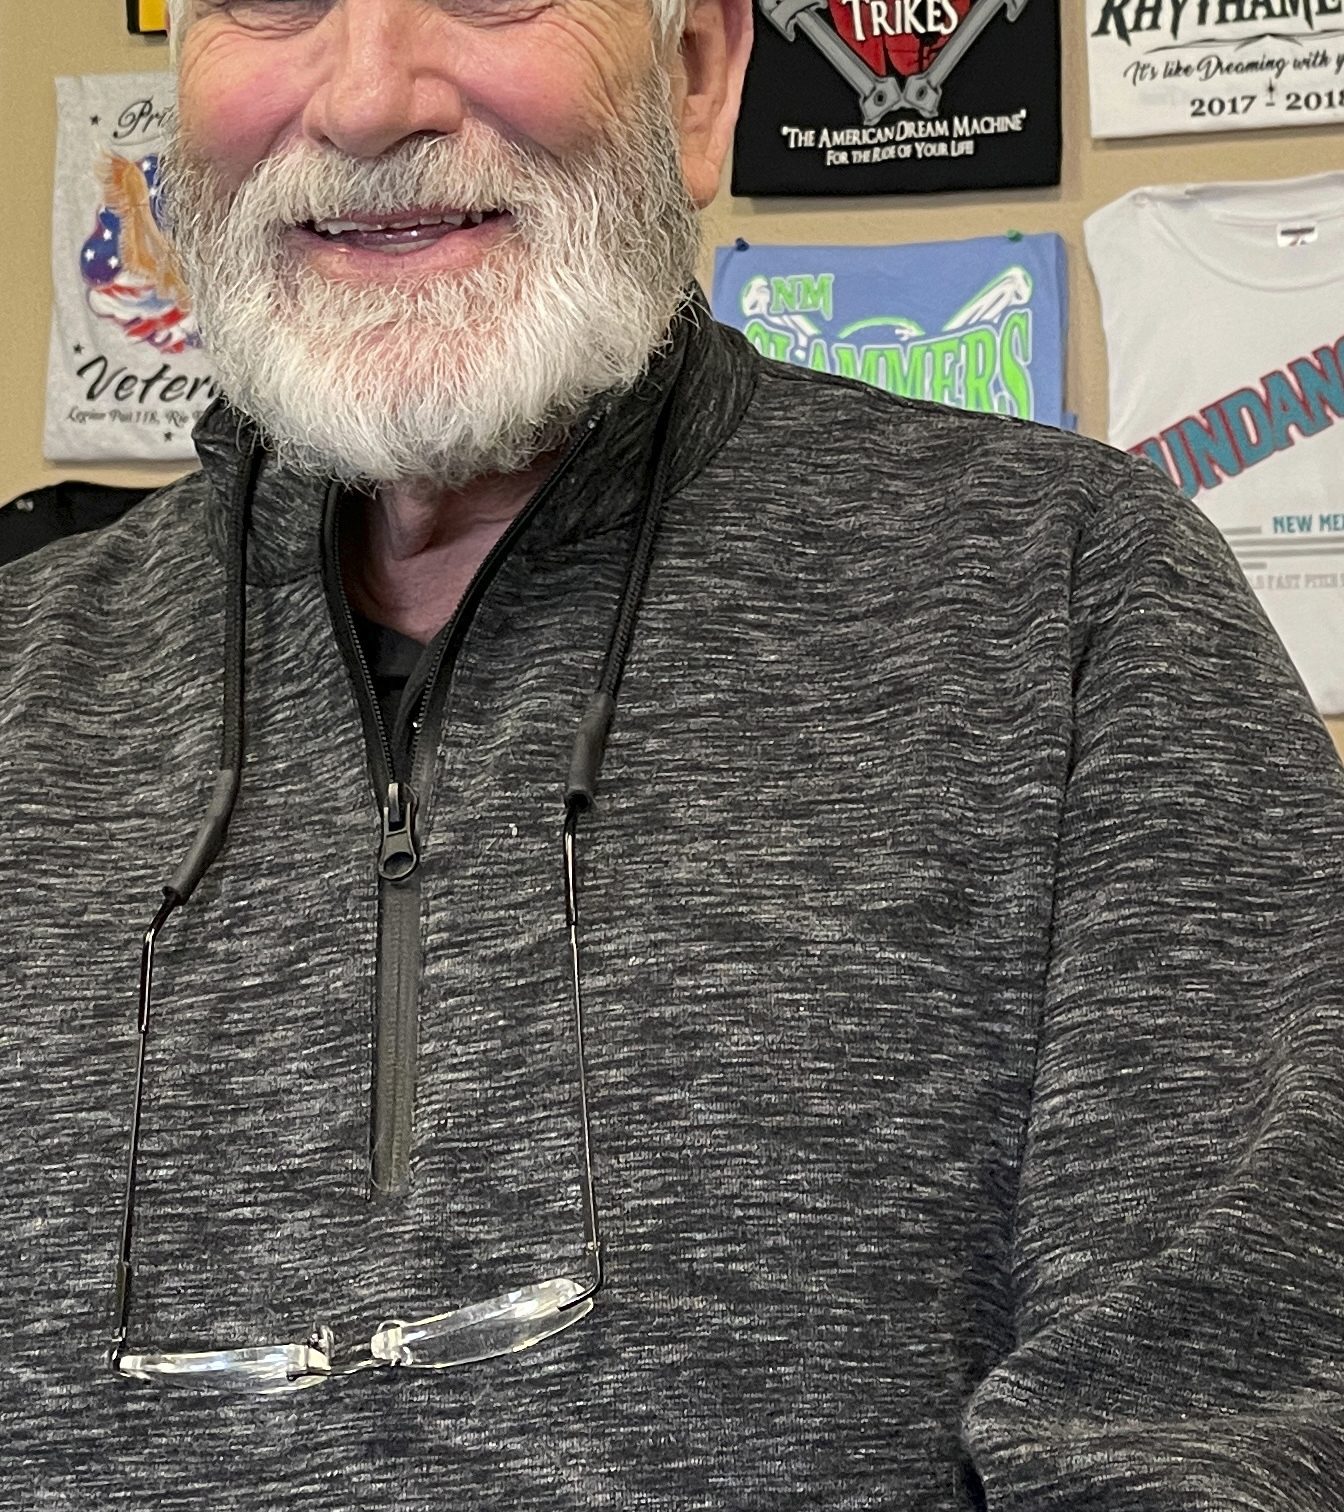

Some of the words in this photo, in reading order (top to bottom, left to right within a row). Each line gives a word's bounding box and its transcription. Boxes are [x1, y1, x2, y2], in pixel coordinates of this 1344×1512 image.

[1162, 55, 1195, 81] like
[1196, 52, 1289, 84] Dreaming
[1189, 95, 1257, 119] 2017
[770, 273, 834, 319] NM
[1272, 515, 1312, 534] NEW
